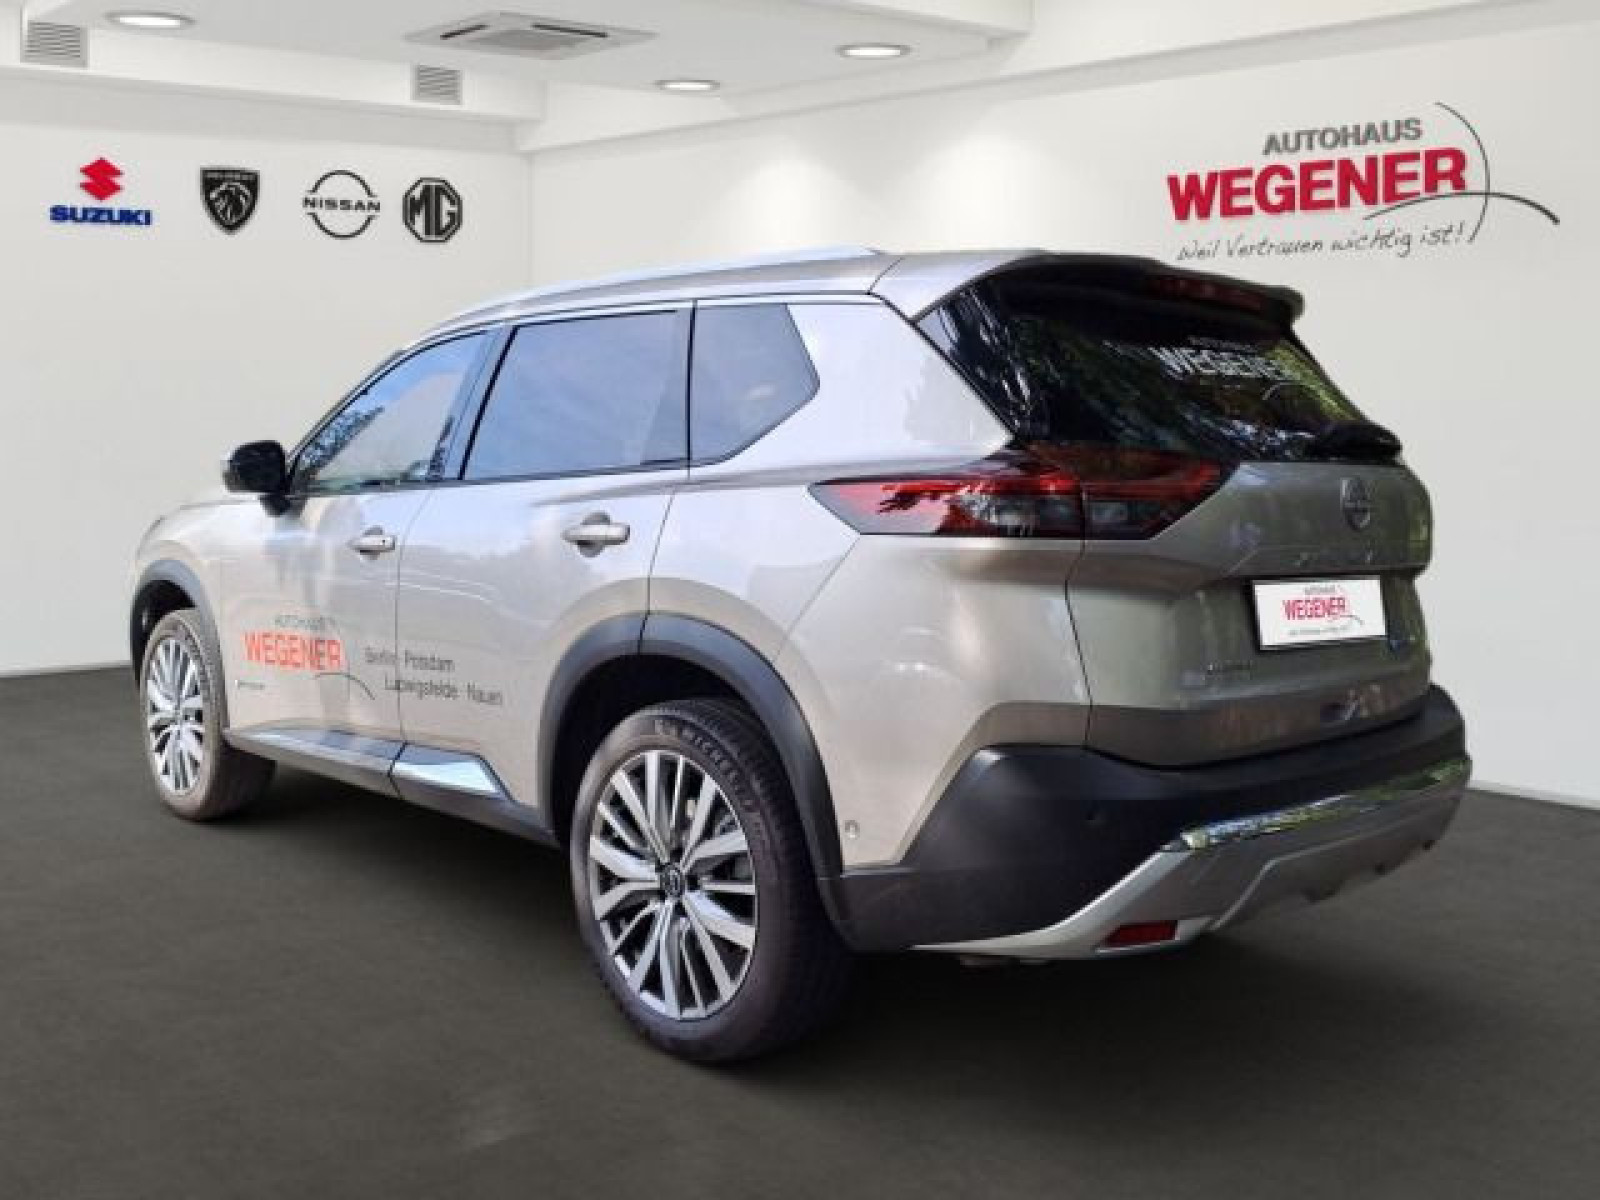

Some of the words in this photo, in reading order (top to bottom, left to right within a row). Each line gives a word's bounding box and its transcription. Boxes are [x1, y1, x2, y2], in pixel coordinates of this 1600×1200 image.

[1263, 117, 1422, 156] AUTOHAUS
[1167, 146, 1467, 221] WEGENER
[49, 203, 152, 226] SUZUKI
[302, 195, 381, 212] NISSAN
[408, 184, 459, 238] MG
[1282, 597, 1346, 621] WEGENER
[241, 631, 342, 671] WEGENER
